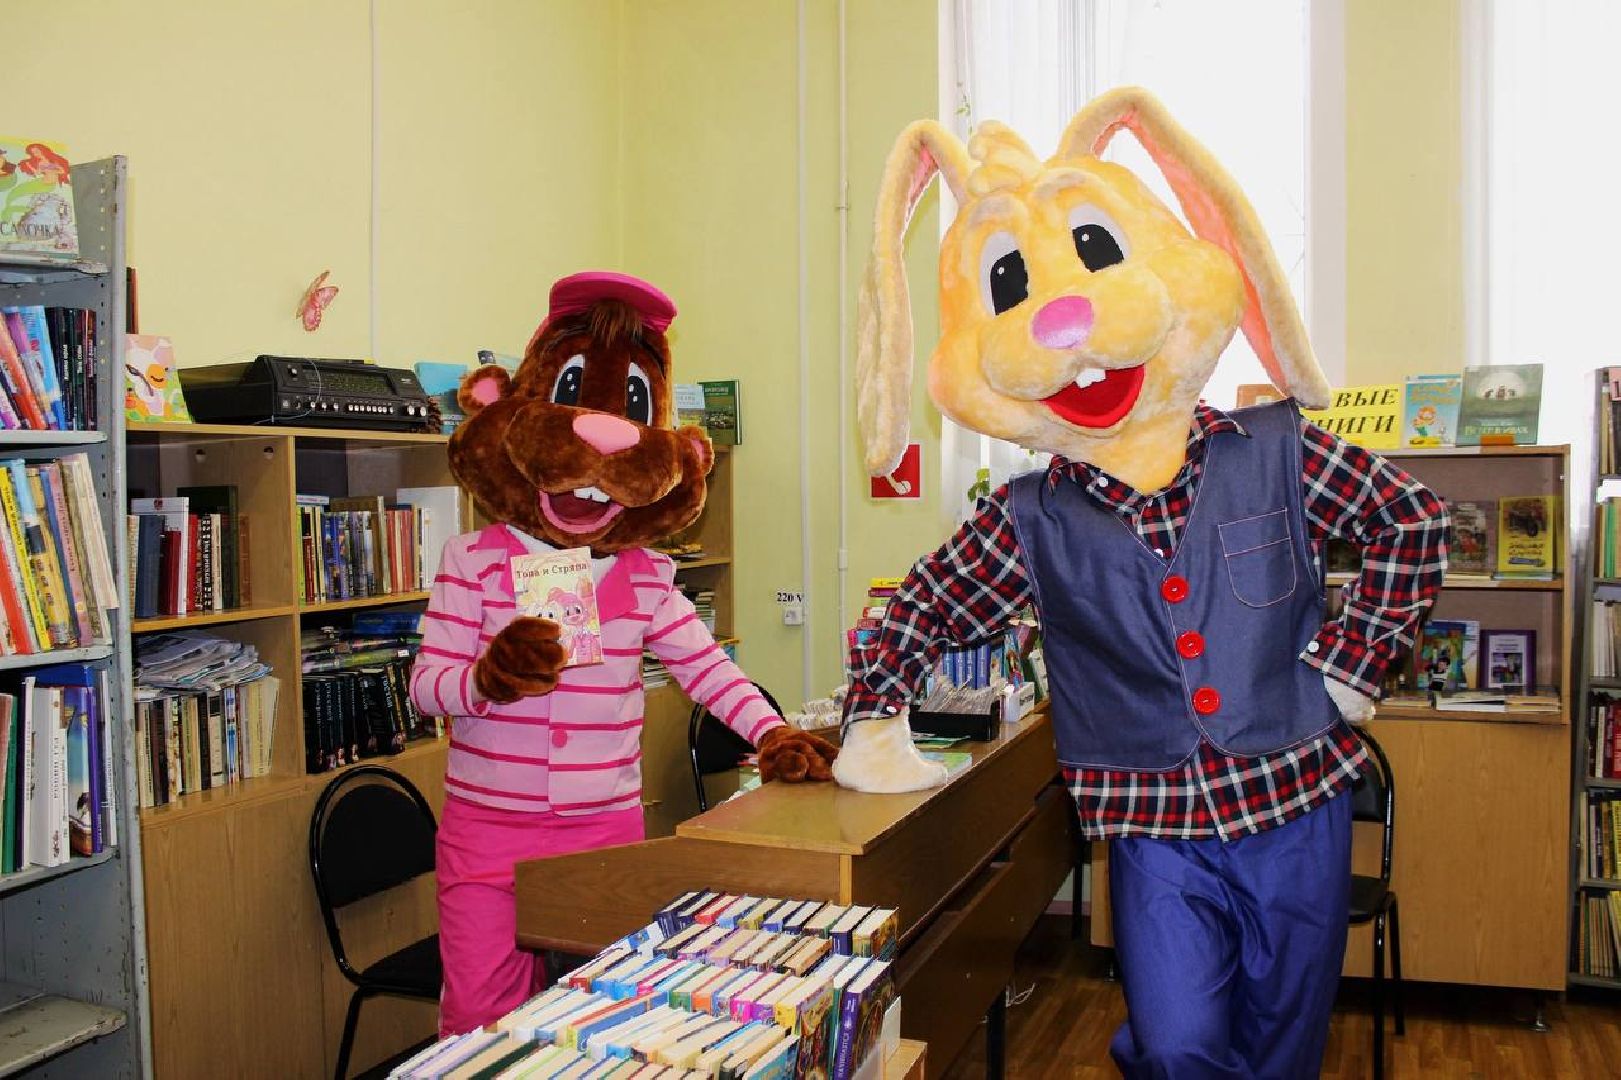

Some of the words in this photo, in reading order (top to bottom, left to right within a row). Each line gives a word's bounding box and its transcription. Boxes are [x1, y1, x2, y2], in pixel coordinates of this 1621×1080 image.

[1336, 388, 1398, 408] ВЫЕ
[1317, 415, 1395, 434] НИГИ
[776, 591, 795, 602] 220
